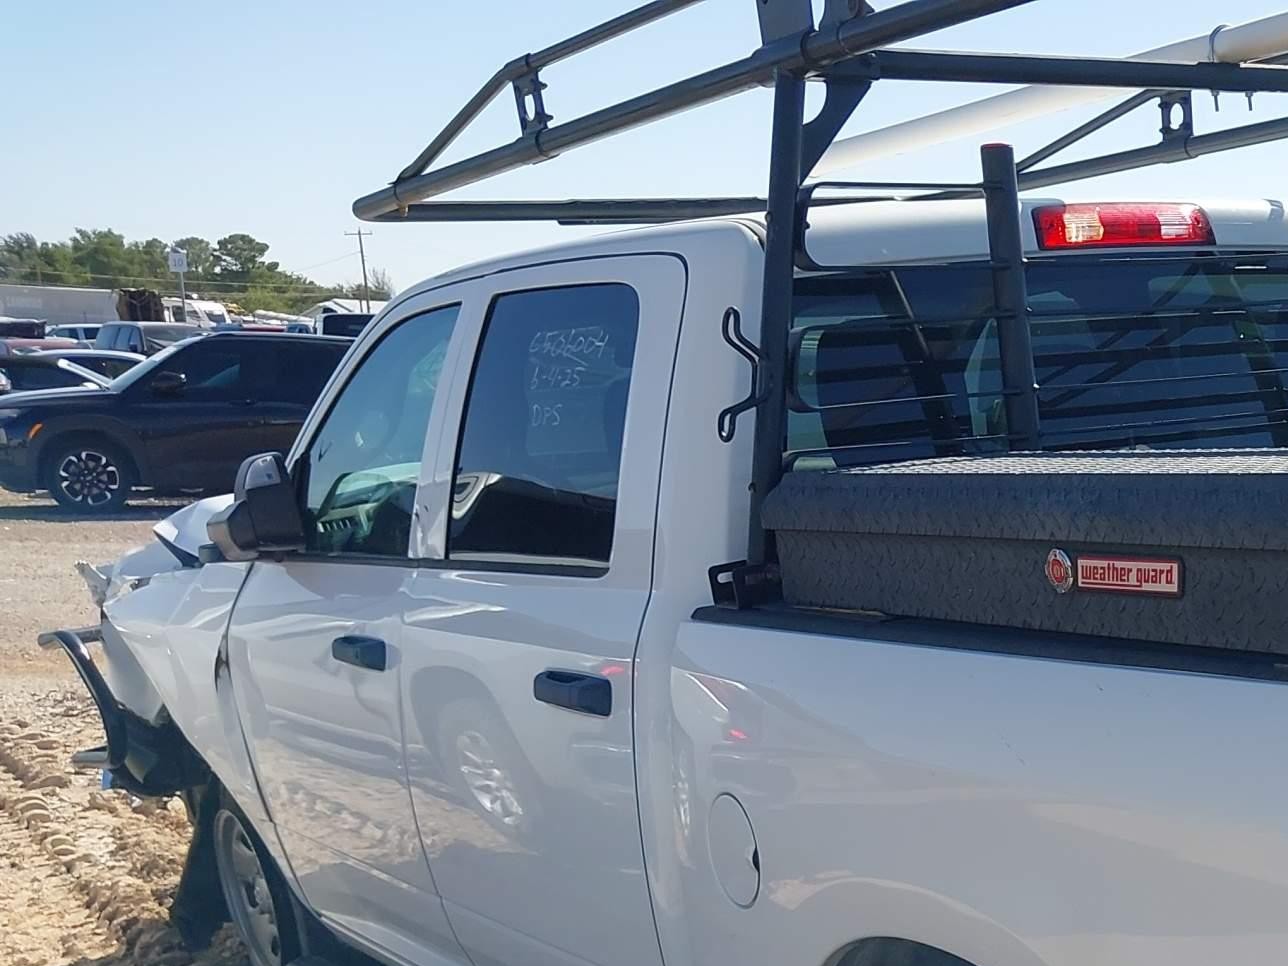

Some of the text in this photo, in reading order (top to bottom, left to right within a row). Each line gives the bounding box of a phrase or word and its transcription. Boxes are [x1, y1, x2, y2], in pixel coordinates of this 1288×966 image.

[531, 403, 563, 427] DPS
[1080, 563, 1174, 587] weather guard
